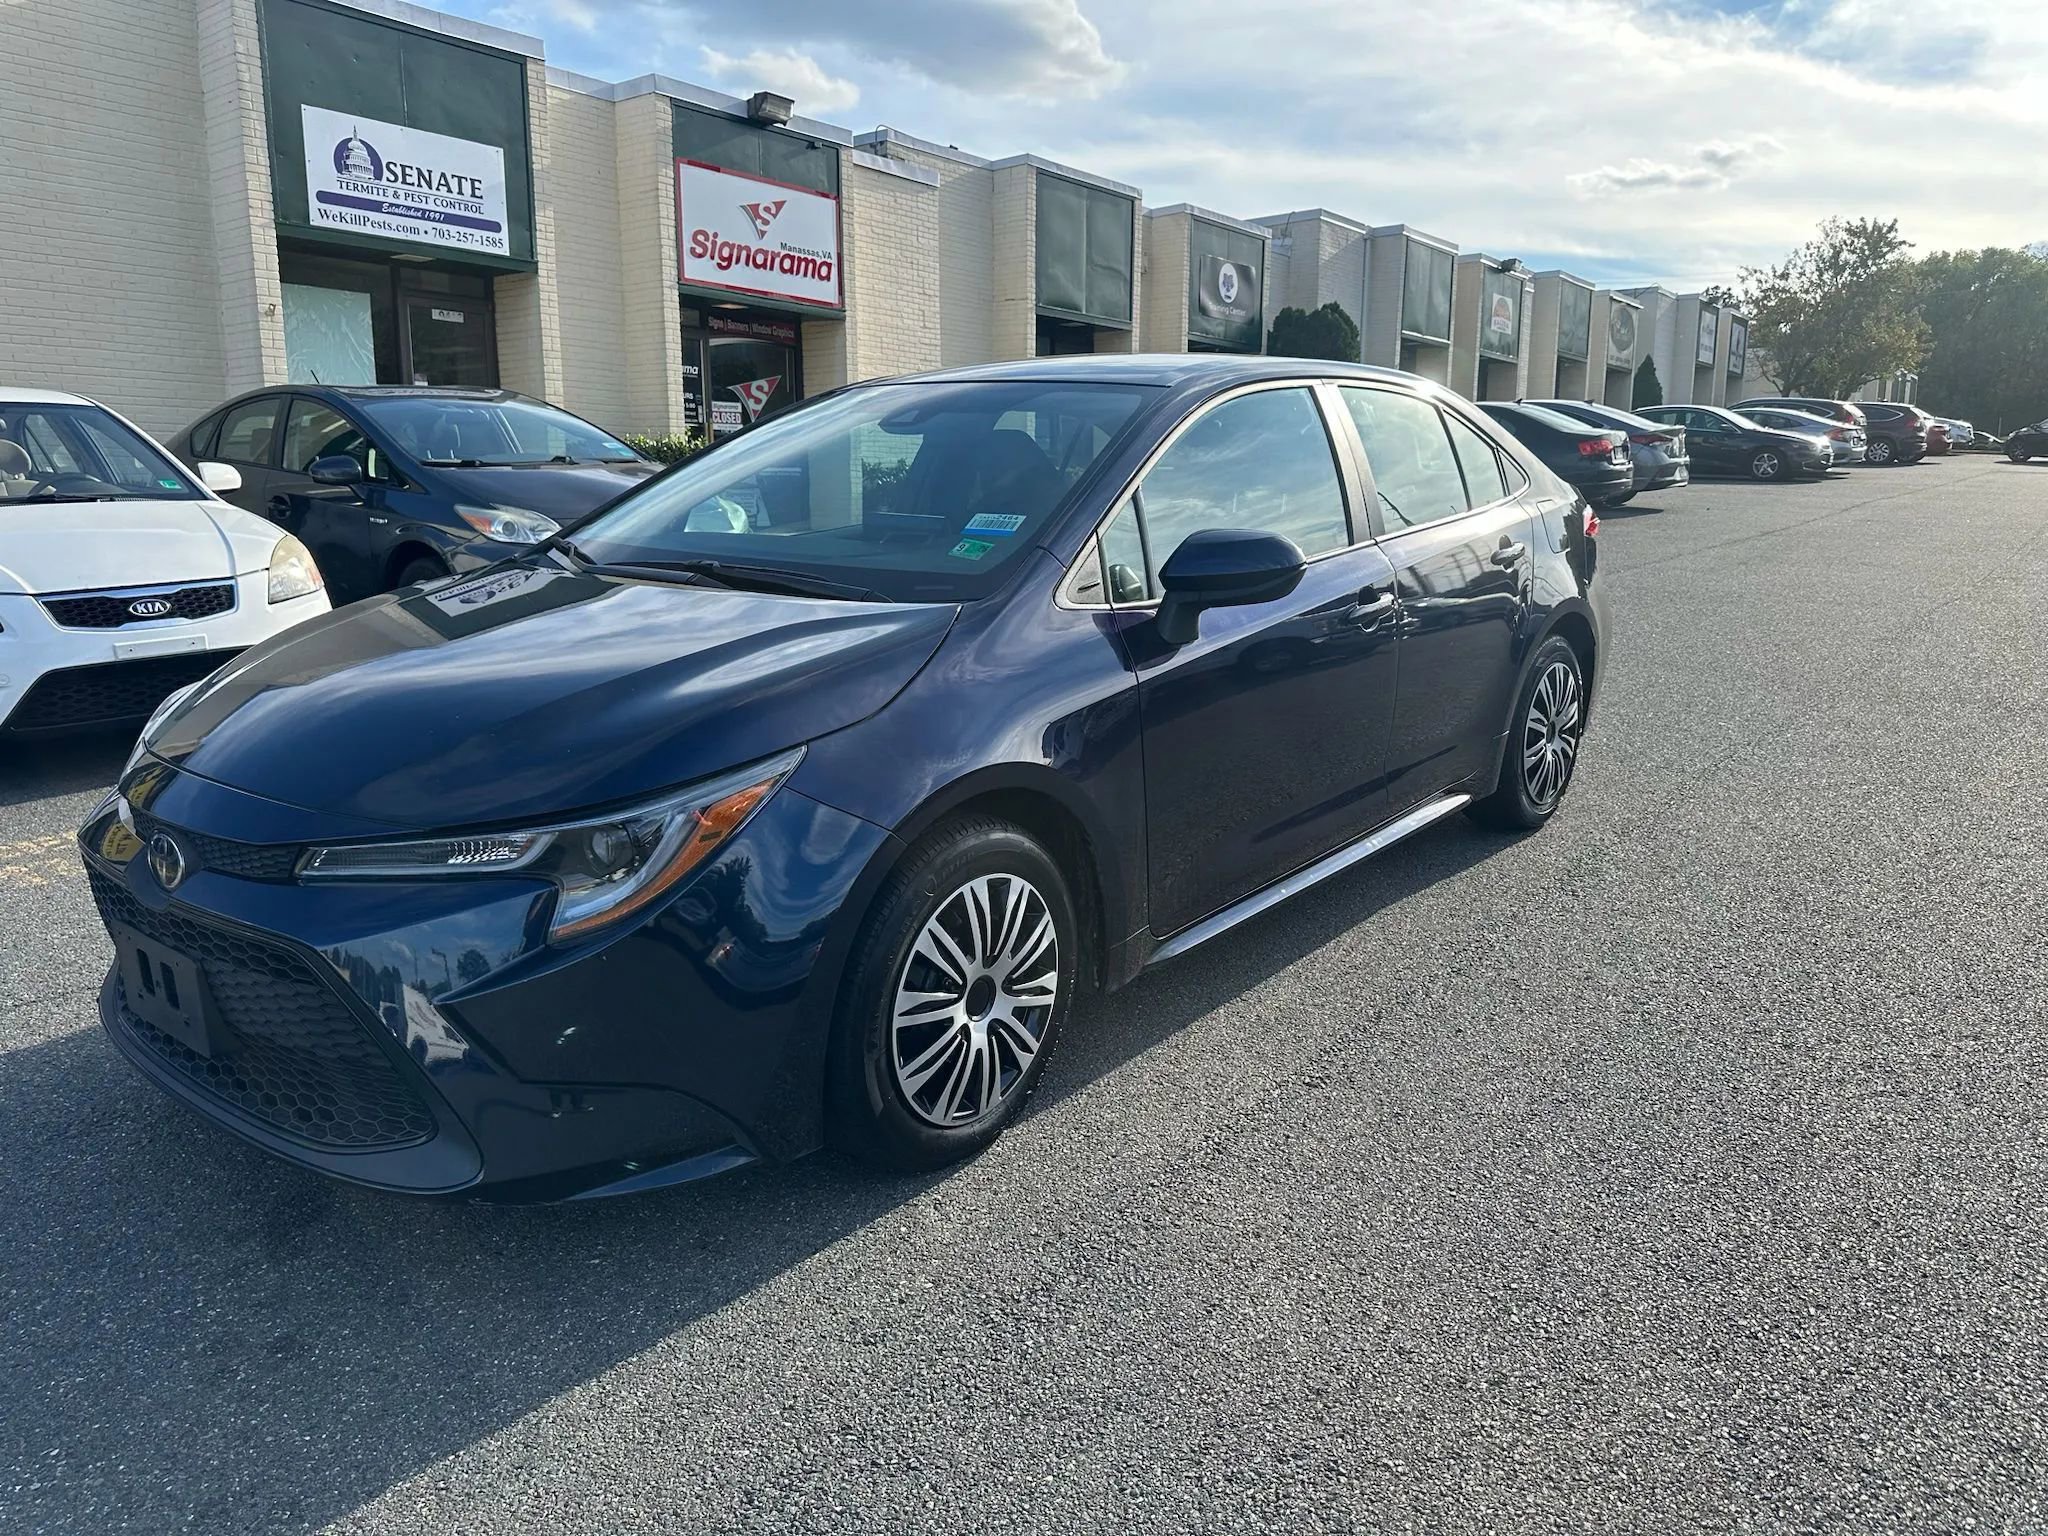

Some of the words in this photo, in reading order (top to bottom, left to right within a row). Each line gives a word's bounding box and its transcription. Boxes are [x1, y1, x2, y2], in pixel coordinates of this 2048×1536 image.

[385, 161, 483, 199] SENATE
[337, 180, 389, 198] TERMITE
[393, 190, 401, 200] &
[404, 193, 430, 205] PEST
[434, 197, 484, 214] CONTROL
[382, 203, 424, 217] Established
[424, 211, 445, 221] 1991
[317, 207, 420, 236] WeKillPests.com
[431, 227, 504, 249] 703-257-1585
[690, 229, 833, 282] Signarama
[780, 241, 833, 260] Manassas,VA
[712, 411, 742, 424] CLOSED
[136, 602, 165, 613] KIA
